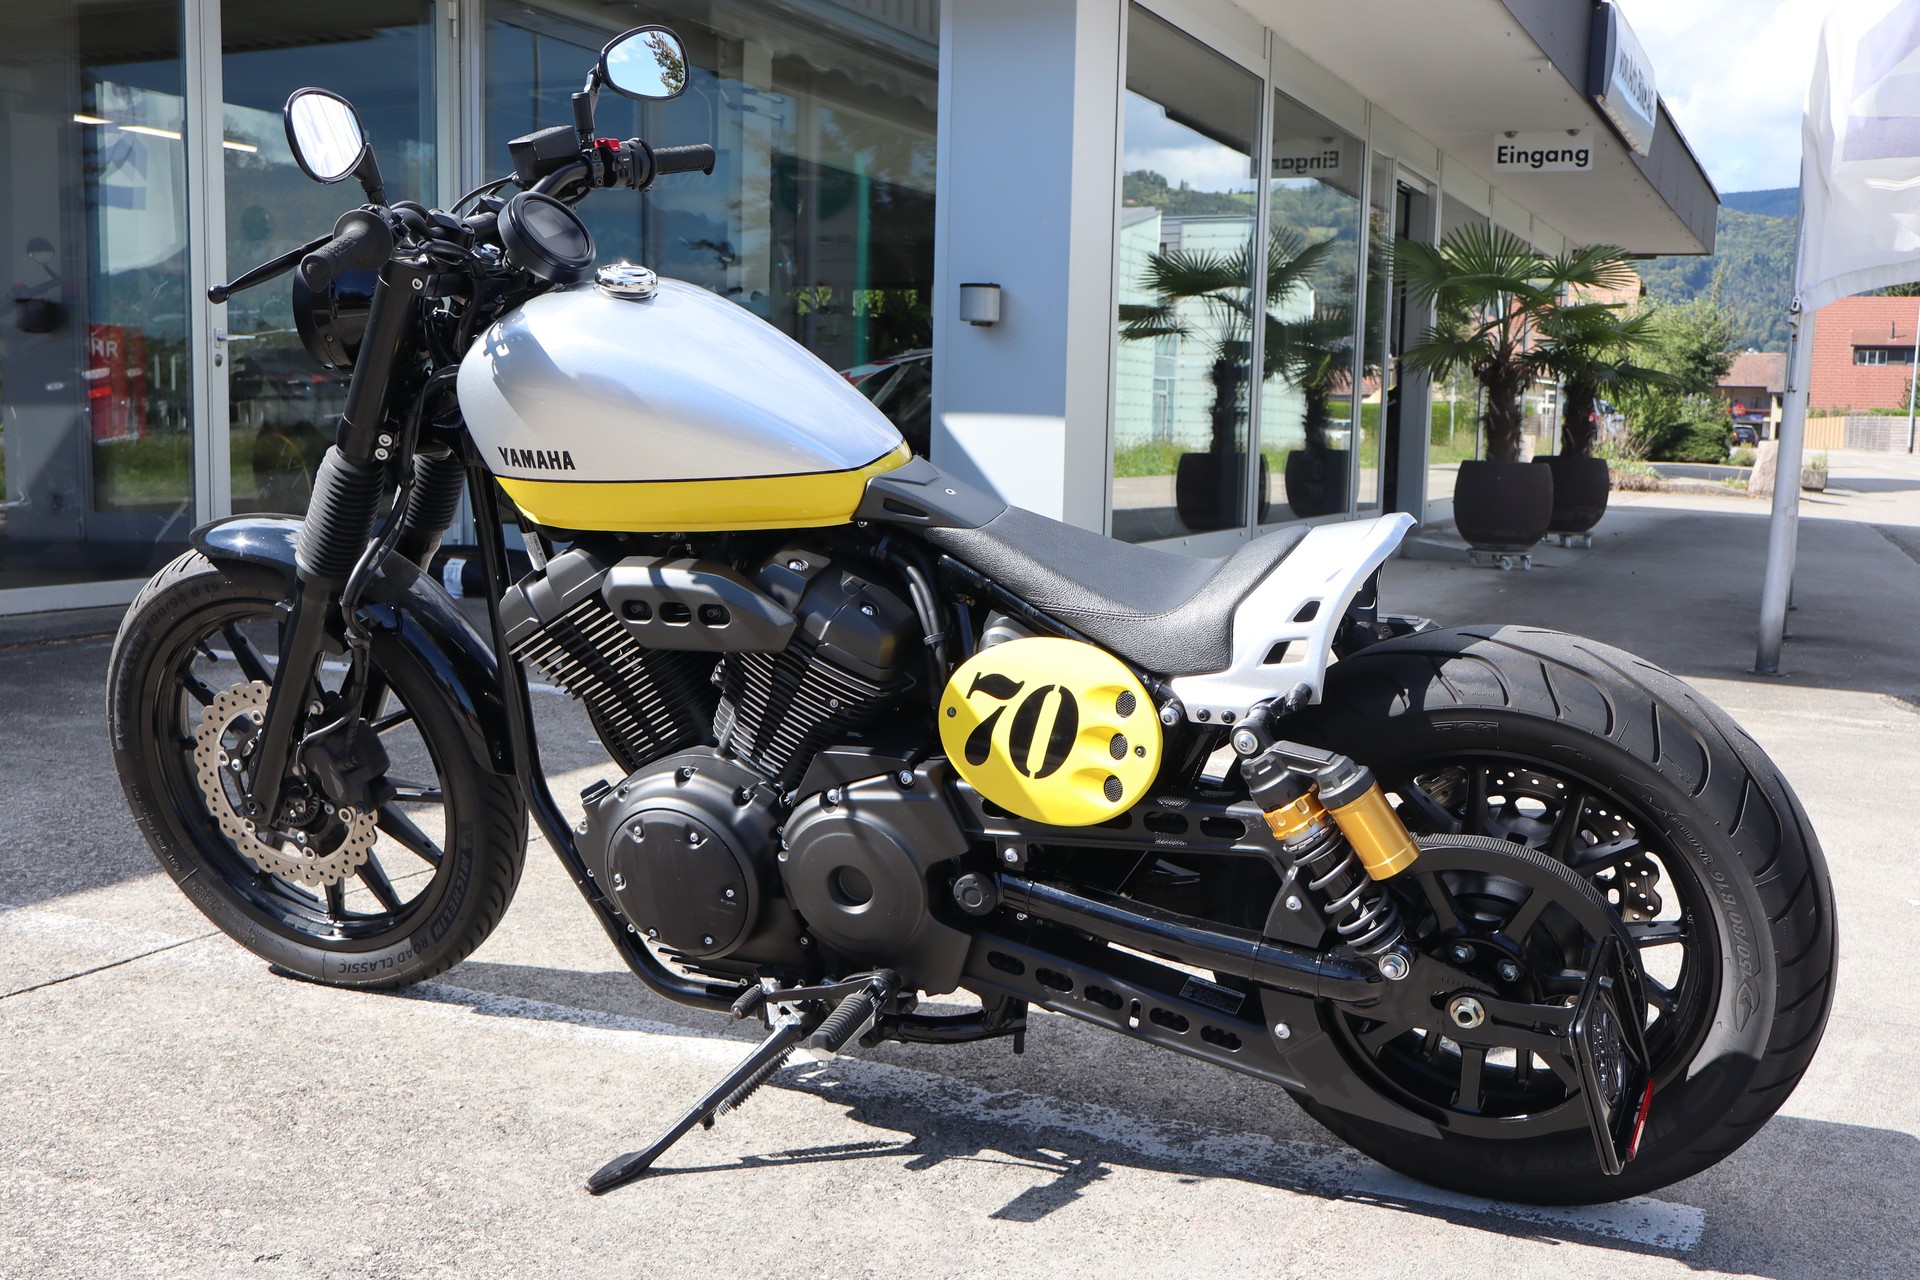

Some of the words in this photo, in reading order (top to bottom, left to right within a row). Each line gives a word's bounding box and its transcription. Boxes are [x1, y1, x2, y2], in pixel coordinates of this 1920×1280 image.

[1497, 145, 1589, 168] Eingang
[498, 446, 576, 470] YAMAHA
[964, 671, 1079, 780] 70
[434, 854, 471, 941] MICHELIN
[397, 937, 429, 963] ROAD
[338, 957, 394, 974] CLASSIC
